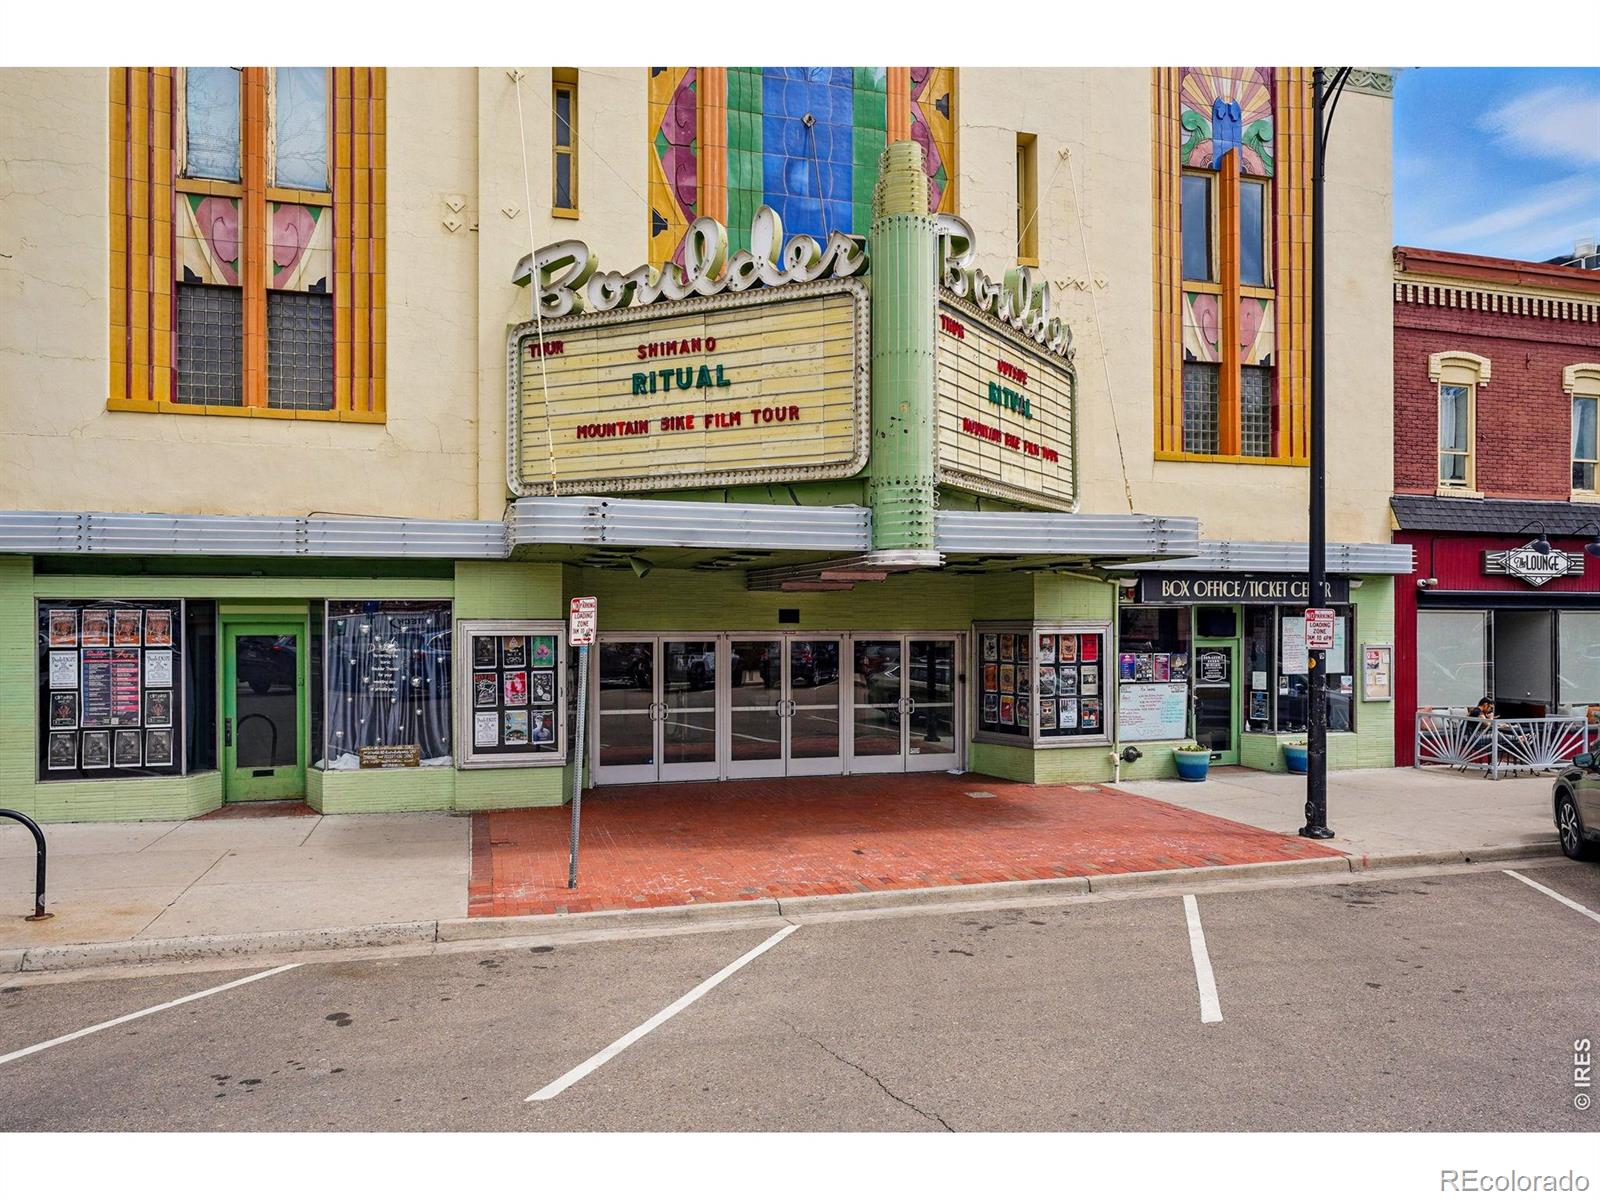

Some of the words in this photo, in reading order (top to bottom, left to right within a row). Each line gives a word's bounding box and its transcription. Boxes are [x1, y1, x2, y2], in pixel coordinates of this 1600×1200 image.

[512, 205, 869, 318] Boulder
[937, 213, 1076, 360] Boulder
[529, 341, 564, 358] THUR
[637, 337, 716, 360] SHIMANO
[632, 364, 731, 396] RITUAL
[988, 381, 1033, 419] RITUAL
[577, 420, 648, 439] MOUNTAIN
[661, 415, 694, 432] BIKE
[704, 411, 741, 428] FILM
[752, 406, 799, 424] TOUR
[1525, 554, 1560, 571] LOUNGE
[1162, 580, 1190, 597] BOX
[1290, 581, 1332, 598] CER
